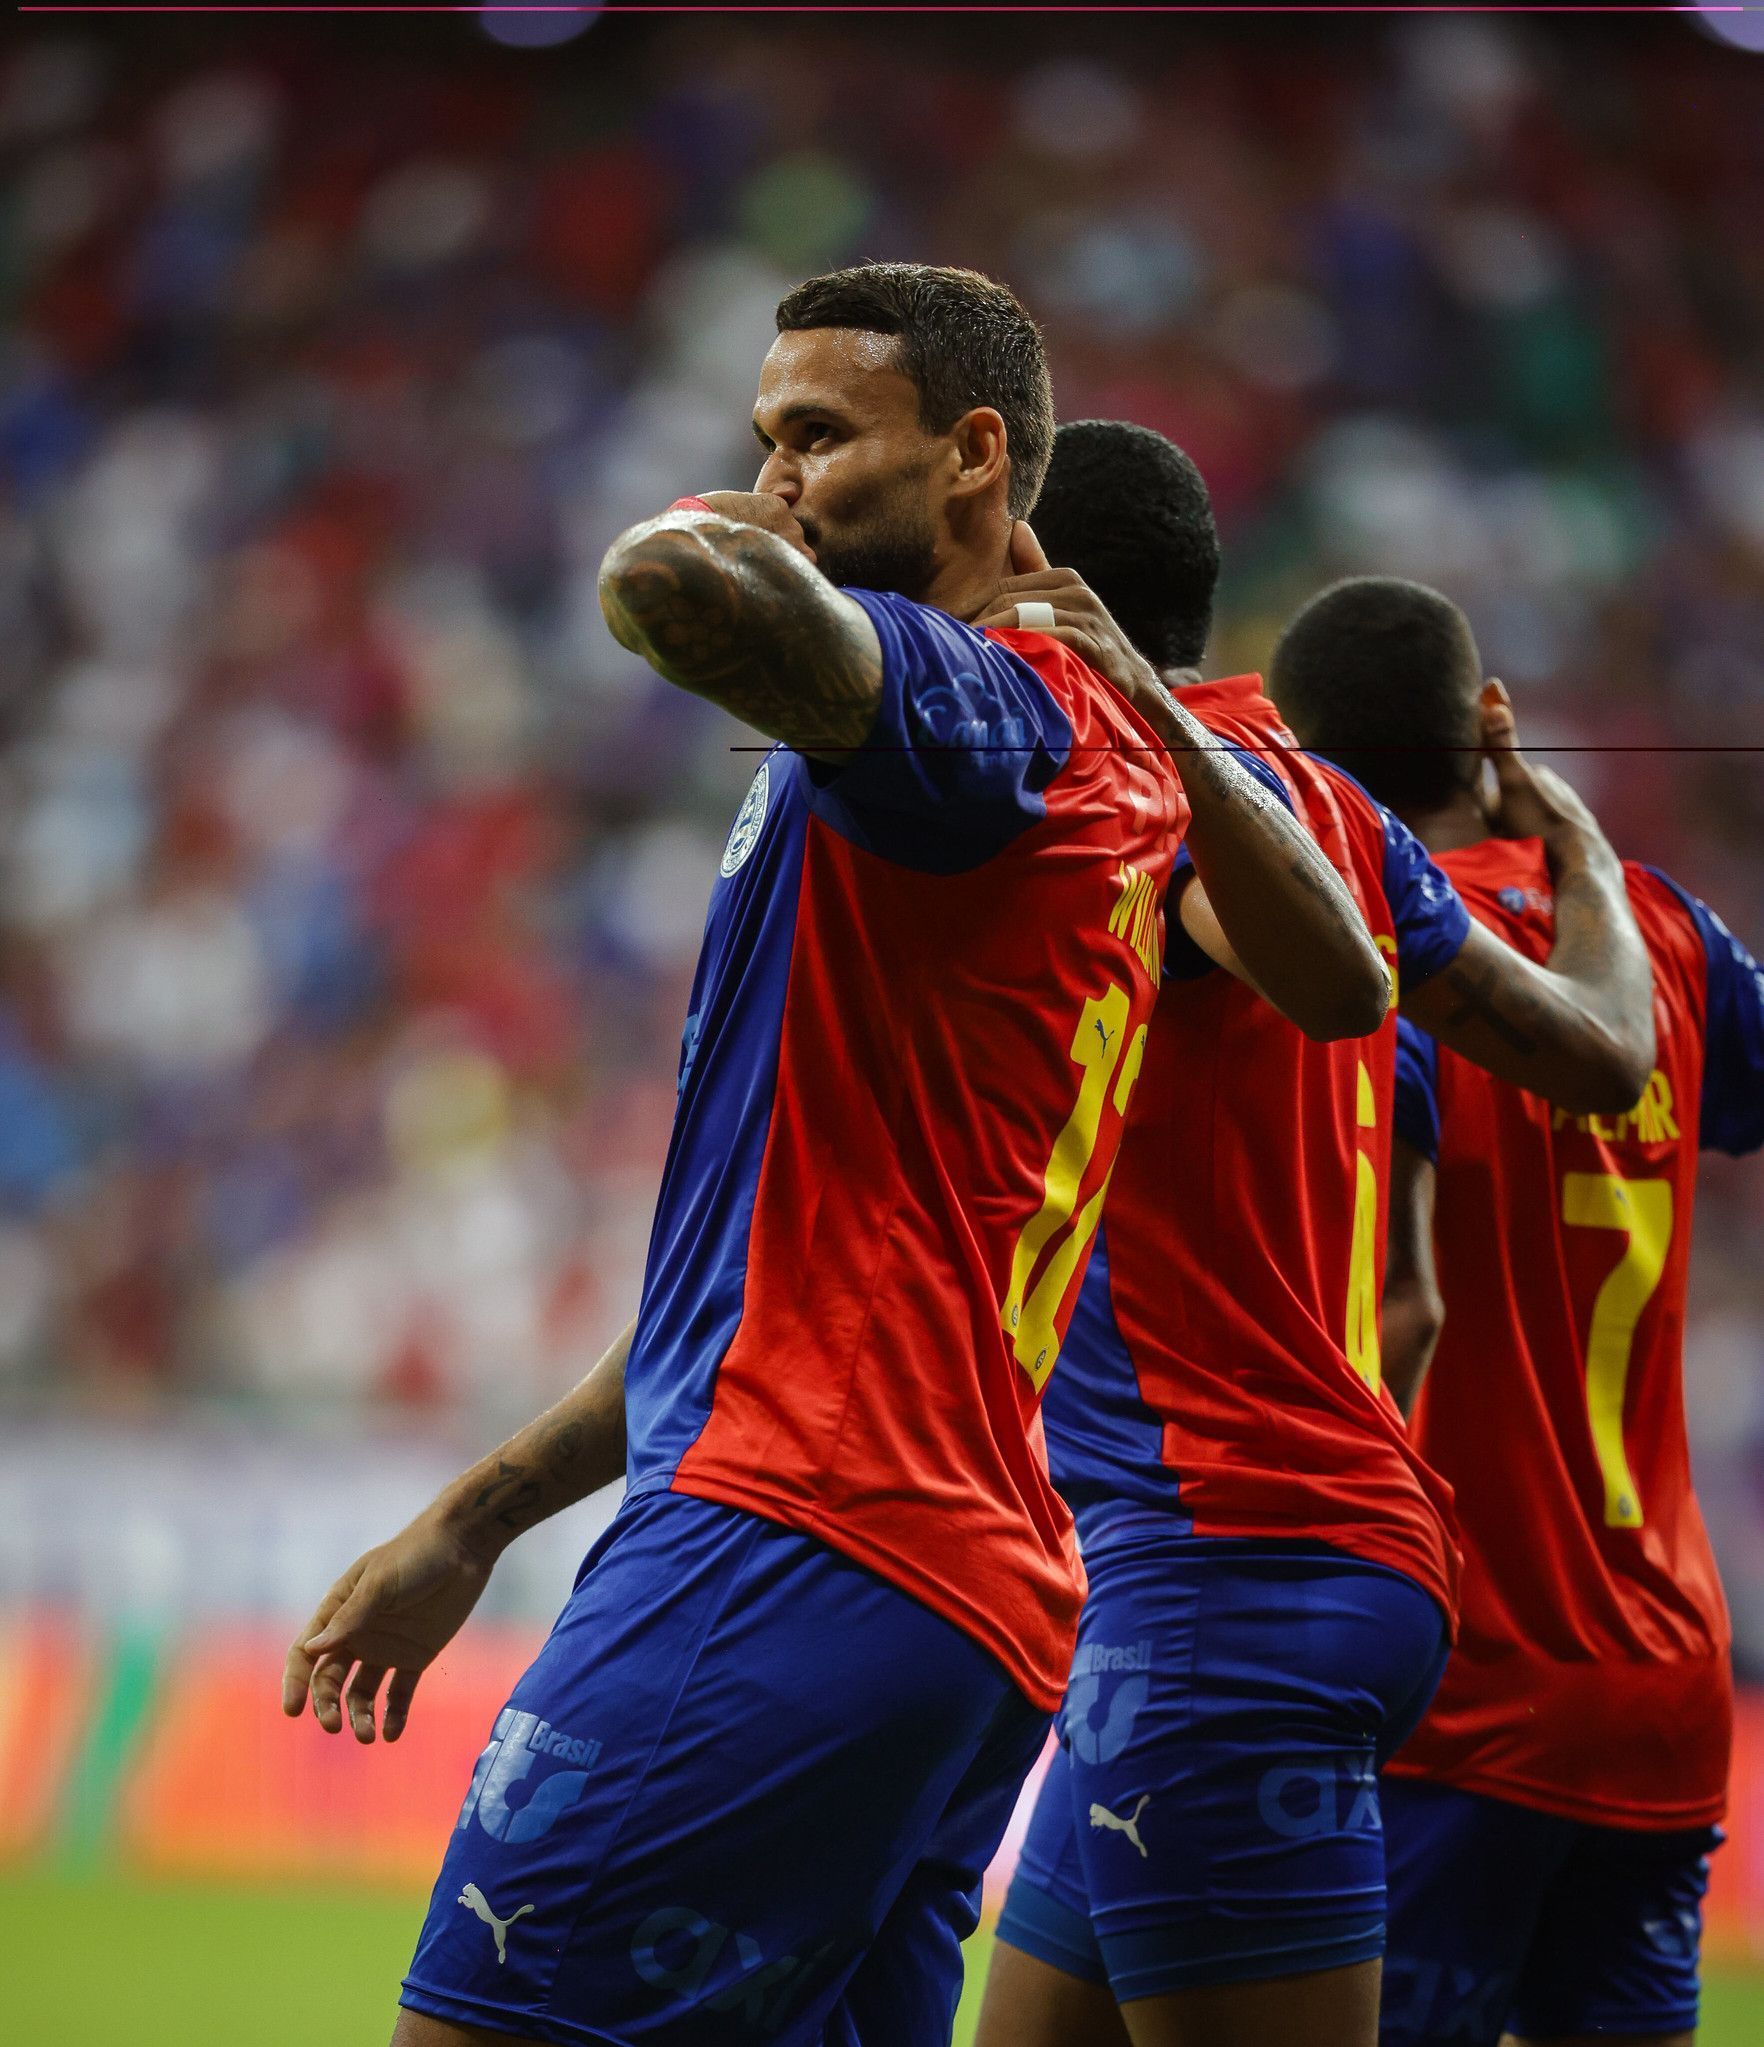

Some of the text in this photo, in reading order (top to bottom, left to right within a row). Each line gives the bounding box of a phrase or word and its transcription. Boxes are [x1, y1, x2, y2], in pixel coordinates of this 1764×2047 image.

[1561, 1173, 1672, 1530] 7
[1091, 1640, 1152, 1674] Brasil
[529, 1720, 603, 1768] Brasil
